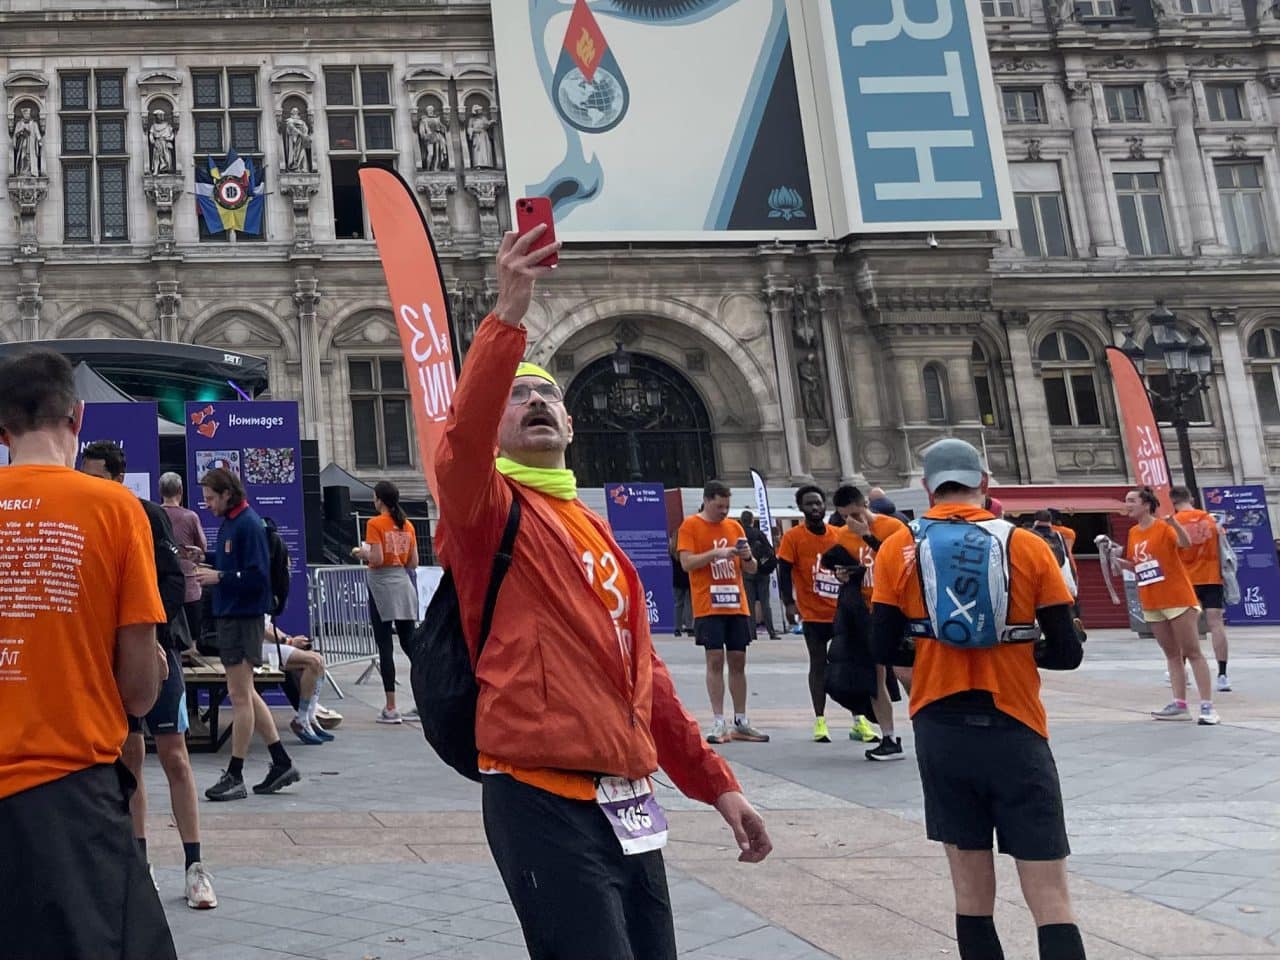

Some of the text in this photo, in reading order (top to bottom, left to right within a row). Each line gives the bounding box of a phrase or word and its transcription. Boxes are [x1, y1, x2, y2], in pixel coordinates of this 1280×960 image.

[229, 414, 284, 429] Hommages
[35, 498, 40, 510] !
[1245, 603, 1267, 616] UNIS
